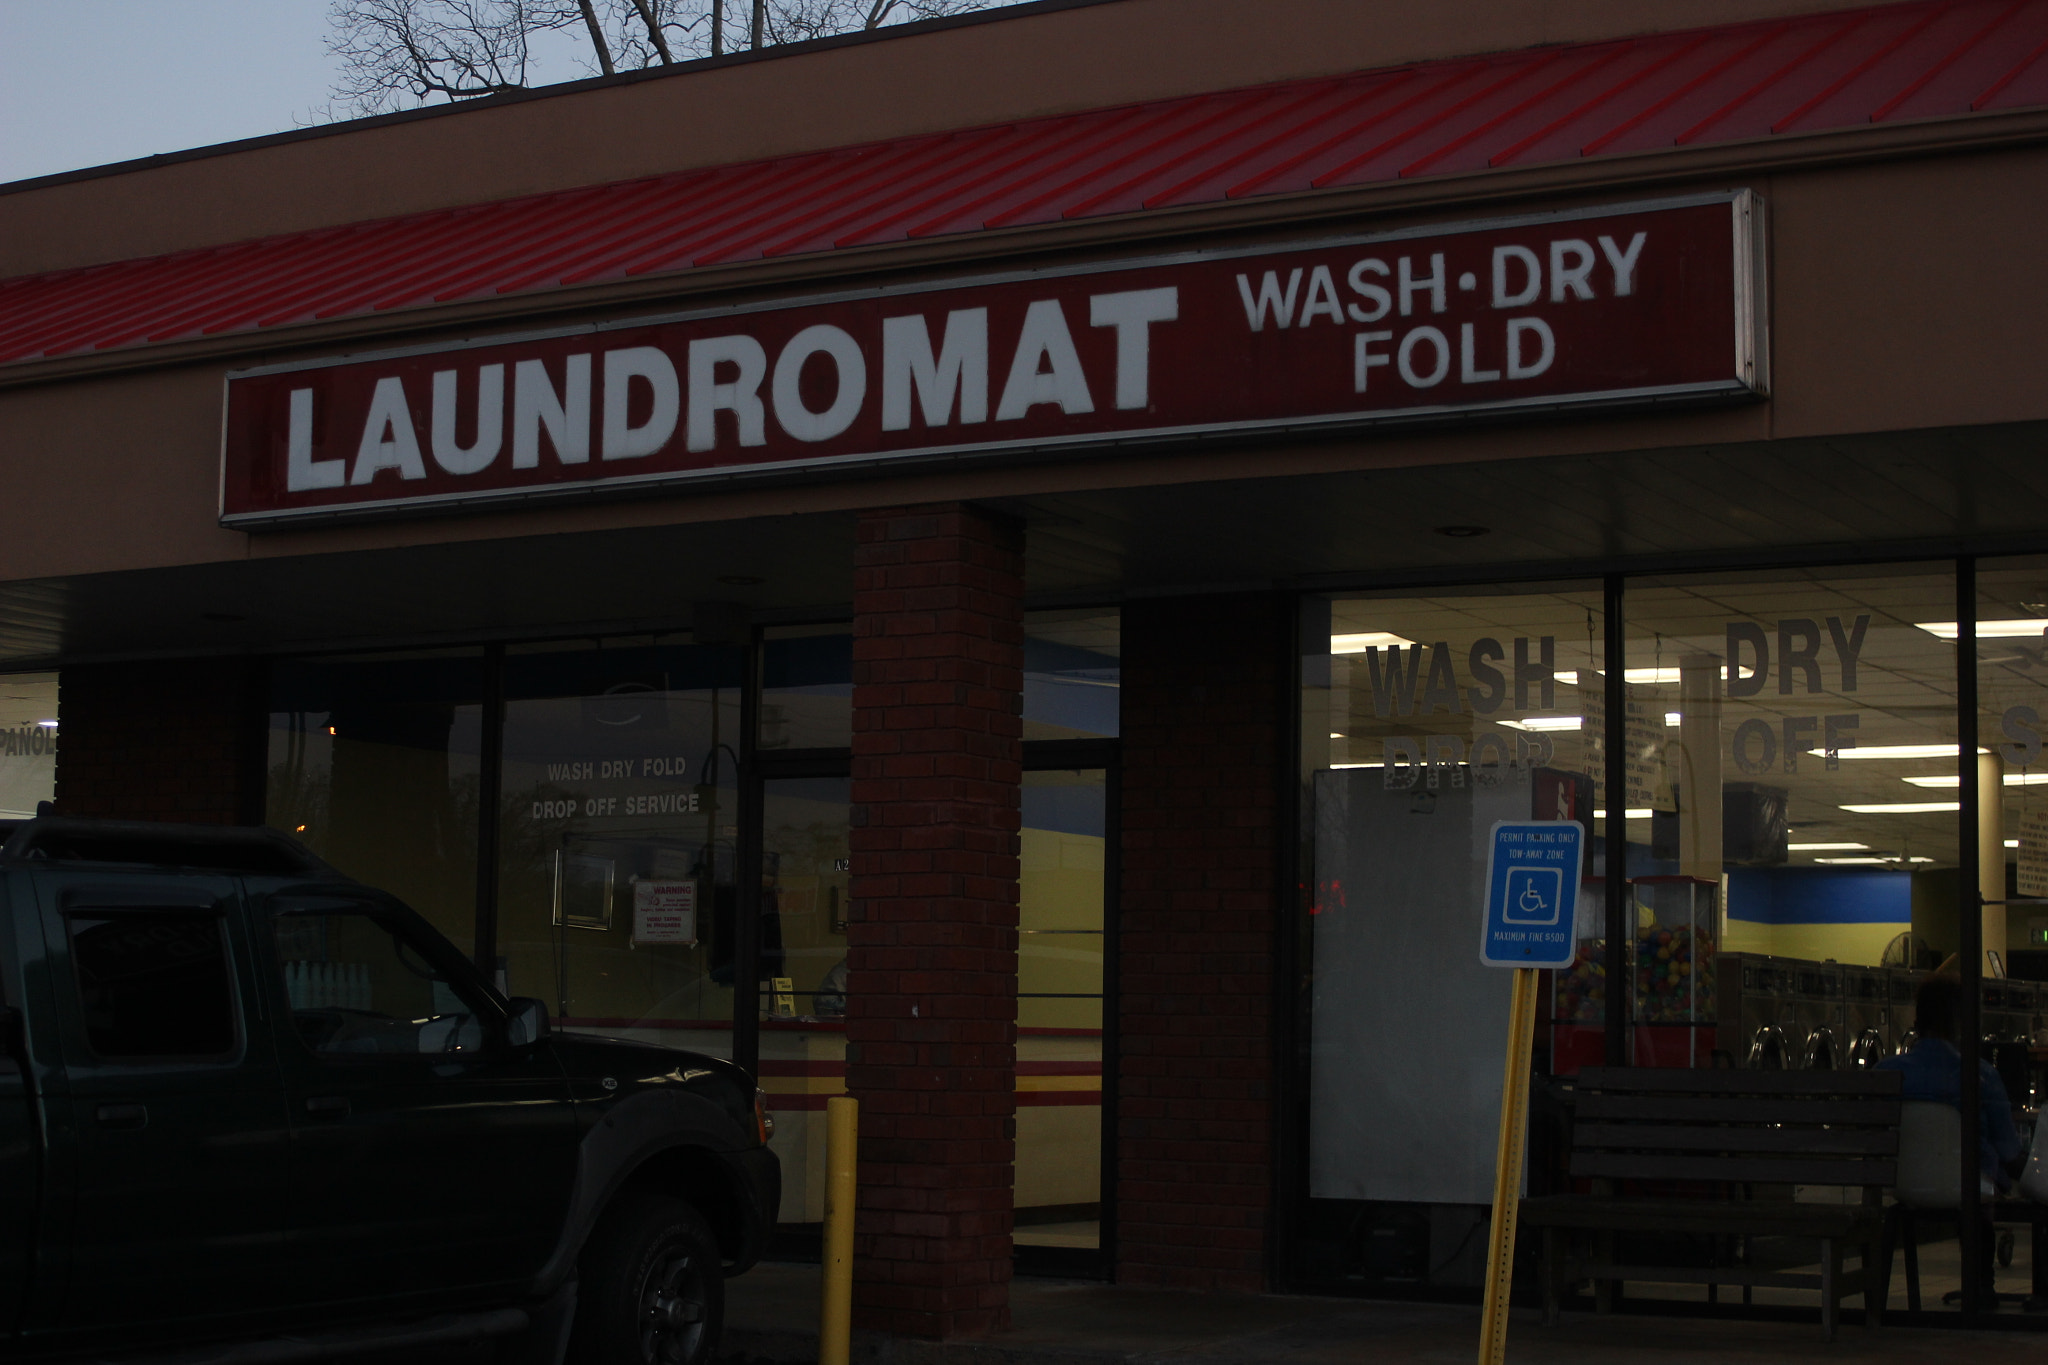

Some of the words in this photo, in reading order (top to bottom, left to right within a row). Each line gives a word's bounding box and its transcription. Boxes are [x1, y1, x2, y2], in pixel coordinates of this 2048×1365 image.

[1353, 315, 1556, 394] FOLD
[286, 286, 1179, 493] LAUNDROMAT
[1364, 636, 1555, 717] WASH
[1726, 614, 1871, 697] DRY
[1382, 731, 1555, 790] DROP
[1731, 713, 1861, 775] OFF
[547, 761, 594, 782] WASH
[601, 759, 635, 779] DRY
[643, 756, 686, 777] FOLD
[532, 799, 577, 819] DROP
[585, 797, 617, 817] OFF
[625, 793, 699, 815] SERVICE
[1499, 832, 1524, 843] PERMIT
[1558, 832, 1576, 843] ONLY
[1546, 849, 1565, 860] ZONE
[653, 886, 692, 895] WARNING
[1493, 930, 1526, 942] MAXIMUM
[1528, 931, 1544, 942] FINE
[1544, 931, 1565, 943] $500
